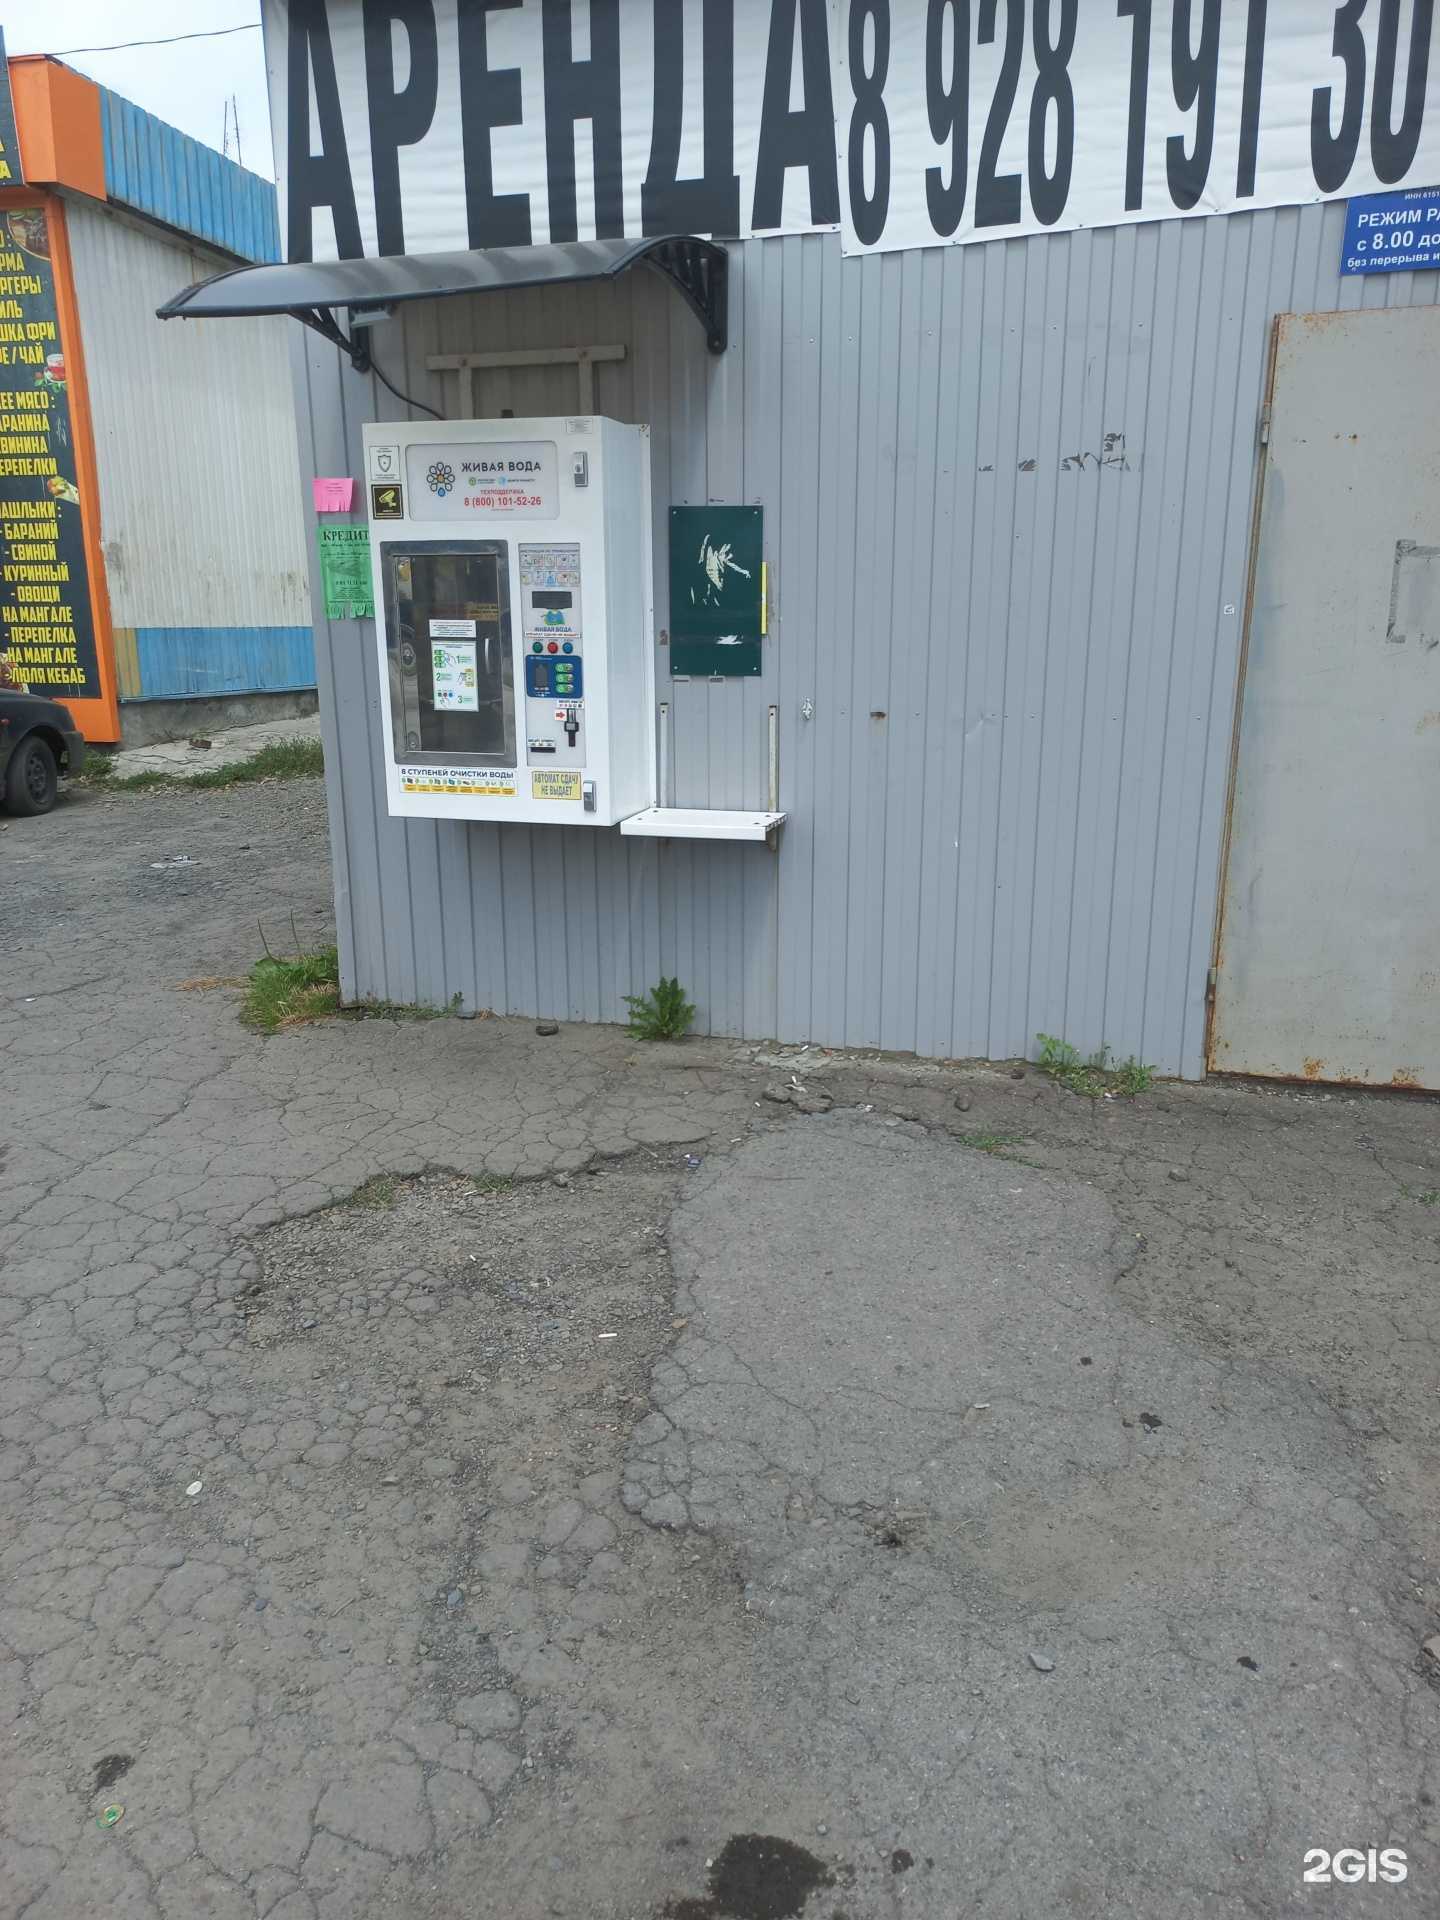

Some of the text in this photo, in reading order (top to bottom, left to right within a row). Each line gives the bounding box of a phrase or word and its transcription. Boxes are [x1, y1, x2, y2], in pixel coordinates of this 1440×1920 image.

[288, 0, 840, 262] АРЕНДА
[848, 0, 890, 246] 8
[926, 0, 1077, 236] 928
[1311, 0, 1434, 193] 30
[1358, 209, 1422, 228] РЕЖИМ
[1356, 230, 1440, 252] с 8.00 до
[1348, 258, 1366, 268] без
[1370, 254, 1429, 266] перерыва
[26, 322, 56, 341] ФРИ
[19, 342, 44, 364] ЧАЙ
[0, 436, 48, 454] ВИНИНА
[462, 461, 542, 472] ЖИВАЯ ВОДА
[0, 501, 55, 518] АШЛЫКИ
[464, 496, 541, 508] 8 (800) 101-52-26
[4, 520, 59, 540] БАРАНИЙ
[323, 530, 368, 541] КРЕДИТ
[11, 541, 56, 561] СВИНОЙ
[3, 562, 69, 581] КУРИННЫЙ
[17, 586, 60, 604] ОВОЩИ
[2, 606, 73, 623] НА МАНГАЛЕ
[10, 627, 76, 643] ПЕРЕПЕЛКА
[7, 647, 77, 663] НА МАНГАЛЕ
[12, 668, 46, 683] ЛЮЛЯ
[47, 668, 86, 684] КЕБАБ
[534, 774, 578, 784] АВТОМАТ СДАЧУ
[541, 785, 572, 796] НЕ ВЫДАЕТ
